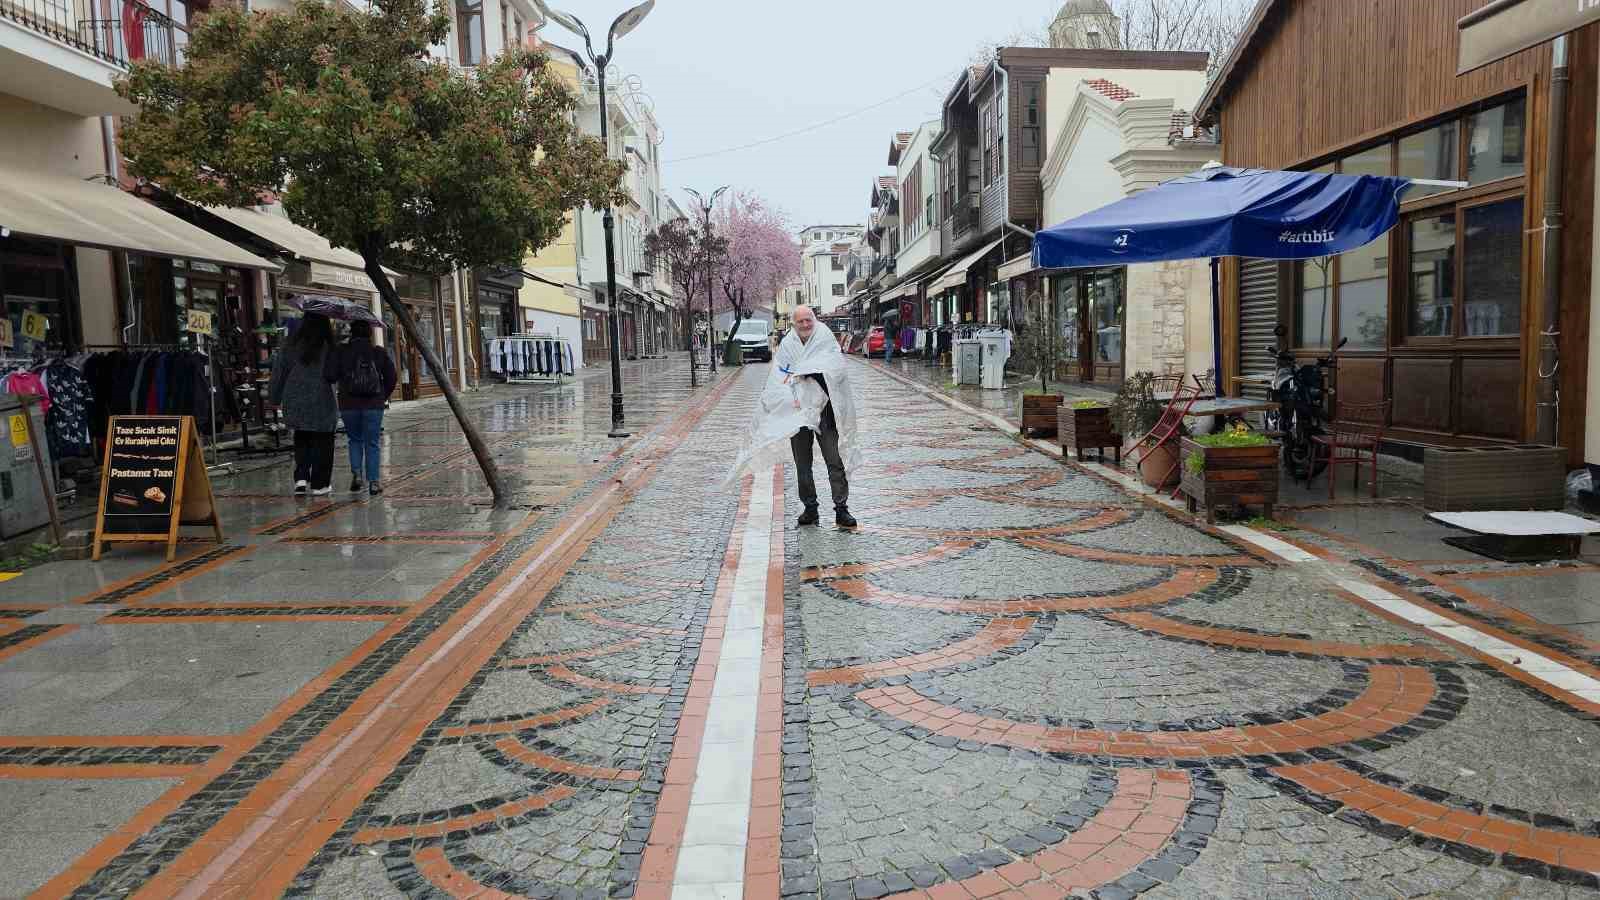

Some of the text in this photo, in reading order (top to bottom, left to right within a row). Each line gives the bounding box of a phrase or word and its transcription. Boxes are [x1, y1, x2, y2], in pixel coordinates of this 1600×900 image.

[1113, 234, 1128, 246] +1
[26, 315, 34, 335] 6
[190, 314, 205, 330] 20
[116, 426, 177, 434] Taze Sıcak Simit
[114, 437, 125, 445] Ev
[110, 468, 174, 478] Pastamız Taze
